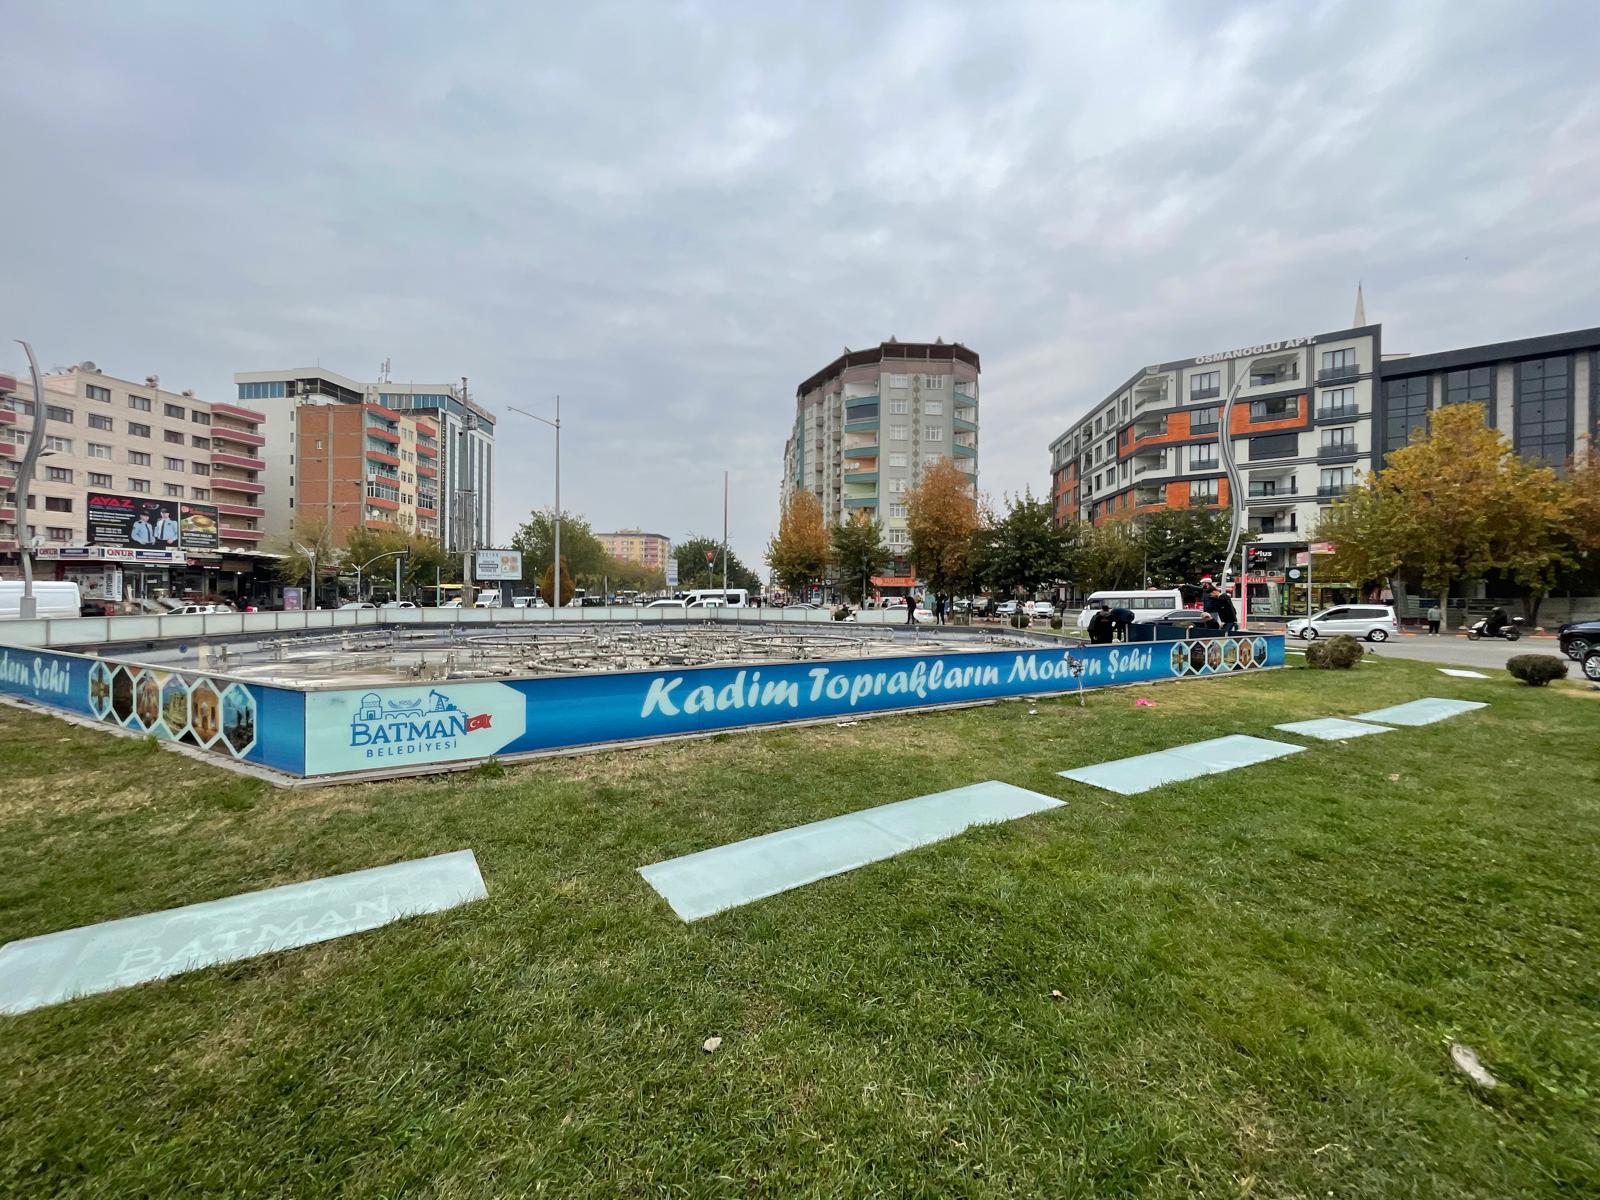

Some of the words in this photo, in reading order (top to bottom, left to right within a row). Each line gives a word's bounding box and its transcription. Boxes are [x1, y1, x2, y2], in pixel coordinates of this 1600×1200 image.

[1284, 336, 1317, 350] APT.
[89, 496, 135, 508] AYAZ
[39, 548, 58, 556] ONUR
[106, 549, 135, 557] ONUR
[33, 657, 70, 696] Şehri
[640, 670, 799, 719] Kadim
[808, 658, 998, 706] Toprakların
[1107, 647, 1152, 680] Şehri
[350, 715, 469, 747] BATMAN
[366, 739, 457, 758] BELEDİYESİ
[108, 897, 391, 978] BATMAN
